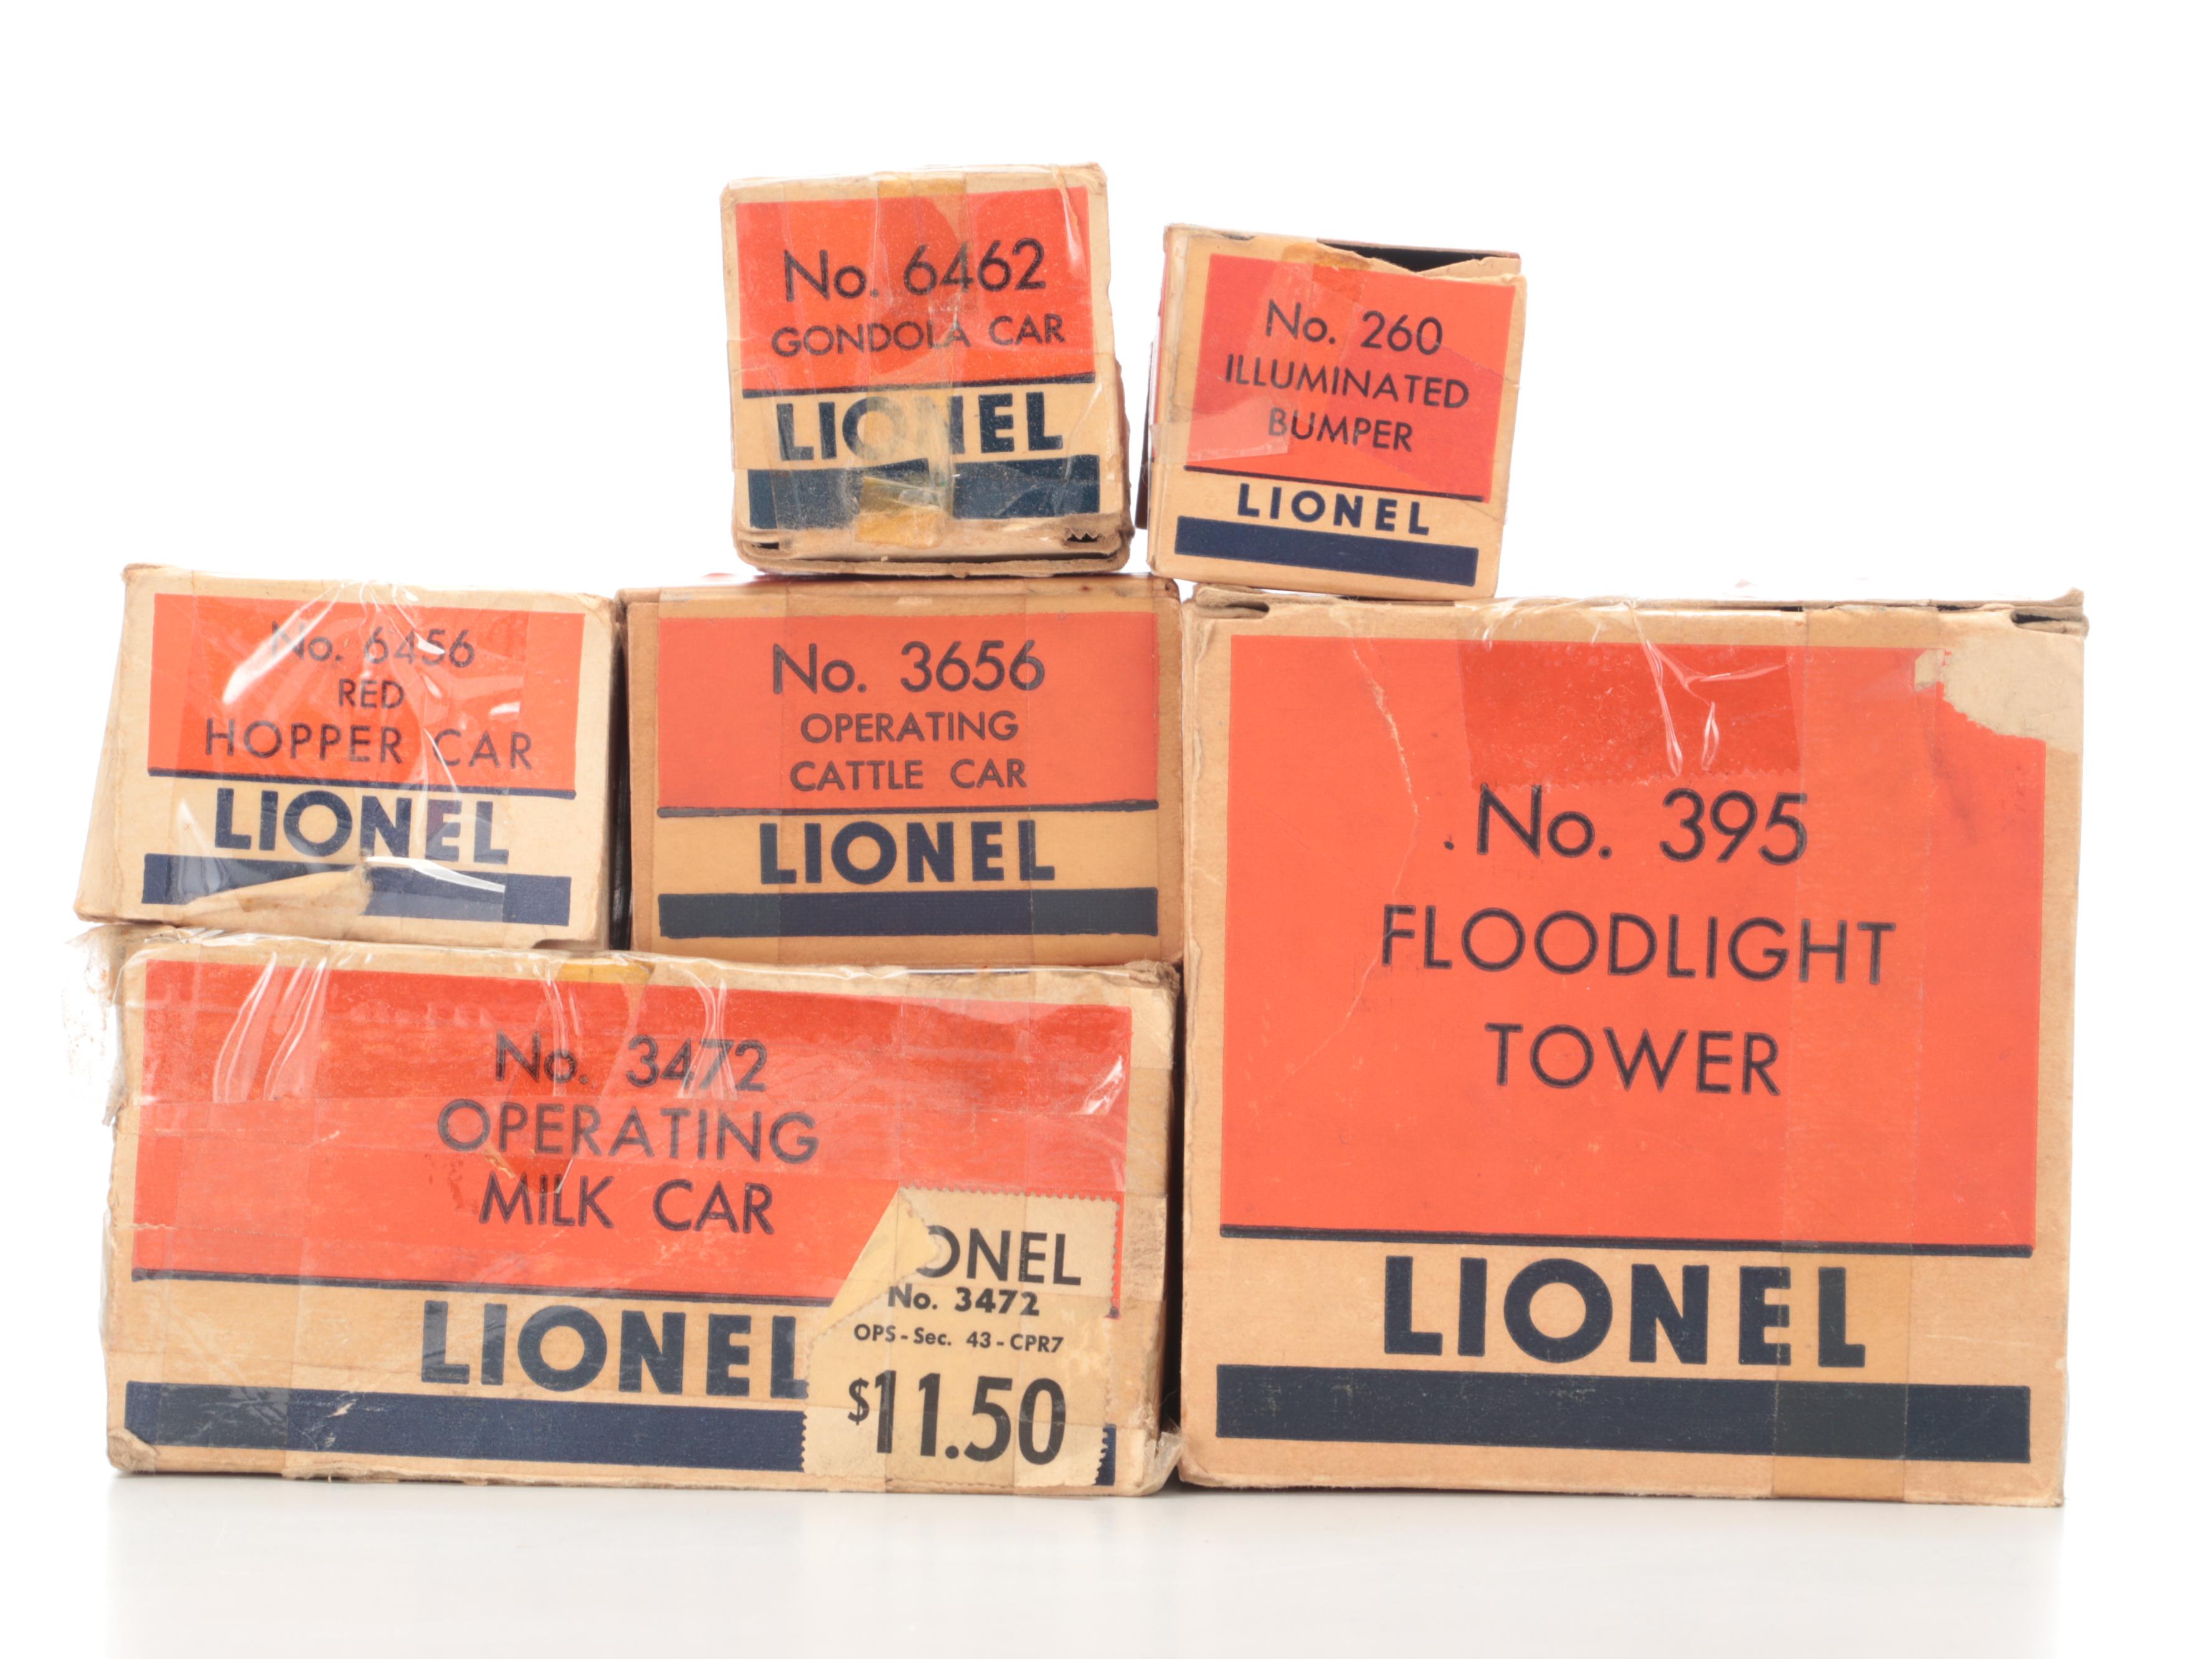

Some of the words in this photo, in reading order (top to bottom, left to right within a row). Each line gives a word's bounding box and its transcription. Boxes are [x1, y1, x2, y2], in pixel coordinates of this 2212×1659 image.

[784, 250, 879, 301] No.
[904, 238, 1046, 295] 6462
[772, 320, 971, 357] GONDOLA
[989, 313, 1064, 345] CAR
[1265, 299, 1336, 344] No.
[1361, 311, 1443, 354] 260
[1225, 354, 1469, 408] ILLUMINATED
[1269, 407, 1413, 452] BUMPER
[1237, 483, 1429, 535] LIONEL
[272, 620, 342, 661] No.
[364, 626, 475, 668] 6456
[773, 643, 866, 694] No.
[900, 640, 1045, 692] 3656
[339, 678, 404, 709] RED
[206, 719, 403, 764] HOPPER
[433, 729, 532, 770] CAR
[800, 711, 1018, 744] OPERATING
[790, 760, 924, 791] CATTLE
[950, 759, 1027, 788] CAR
[214, 788, 509, 864] LIONEL
[759, 820, 1055, 885] LIONEL
[1477, 783, 1612, 858] No.
[1659, 788, 1808, 865] 395
[1382, 904, 1896, 985] FLOODLIGHT
[496, 1030, 588, 1084] No.
[626, 1034, 767, 1092] 3472
[1485, 1024, 1780, 1096] TOWER
[438, 1099, 819, 1164] OPERATING
[479, 1170, 615, 1228] MILK
[653, 1179, 775, 1234] CAR
[887, 1283, 938, 1310] No.
[954, 1287, 1039, 1316] 3472
[1384, 1255, 1866, 1368] LIONEL
[421, 1300, 810, 1399] LIONEL
[848, 1370, 1066, 1465] $11.50
